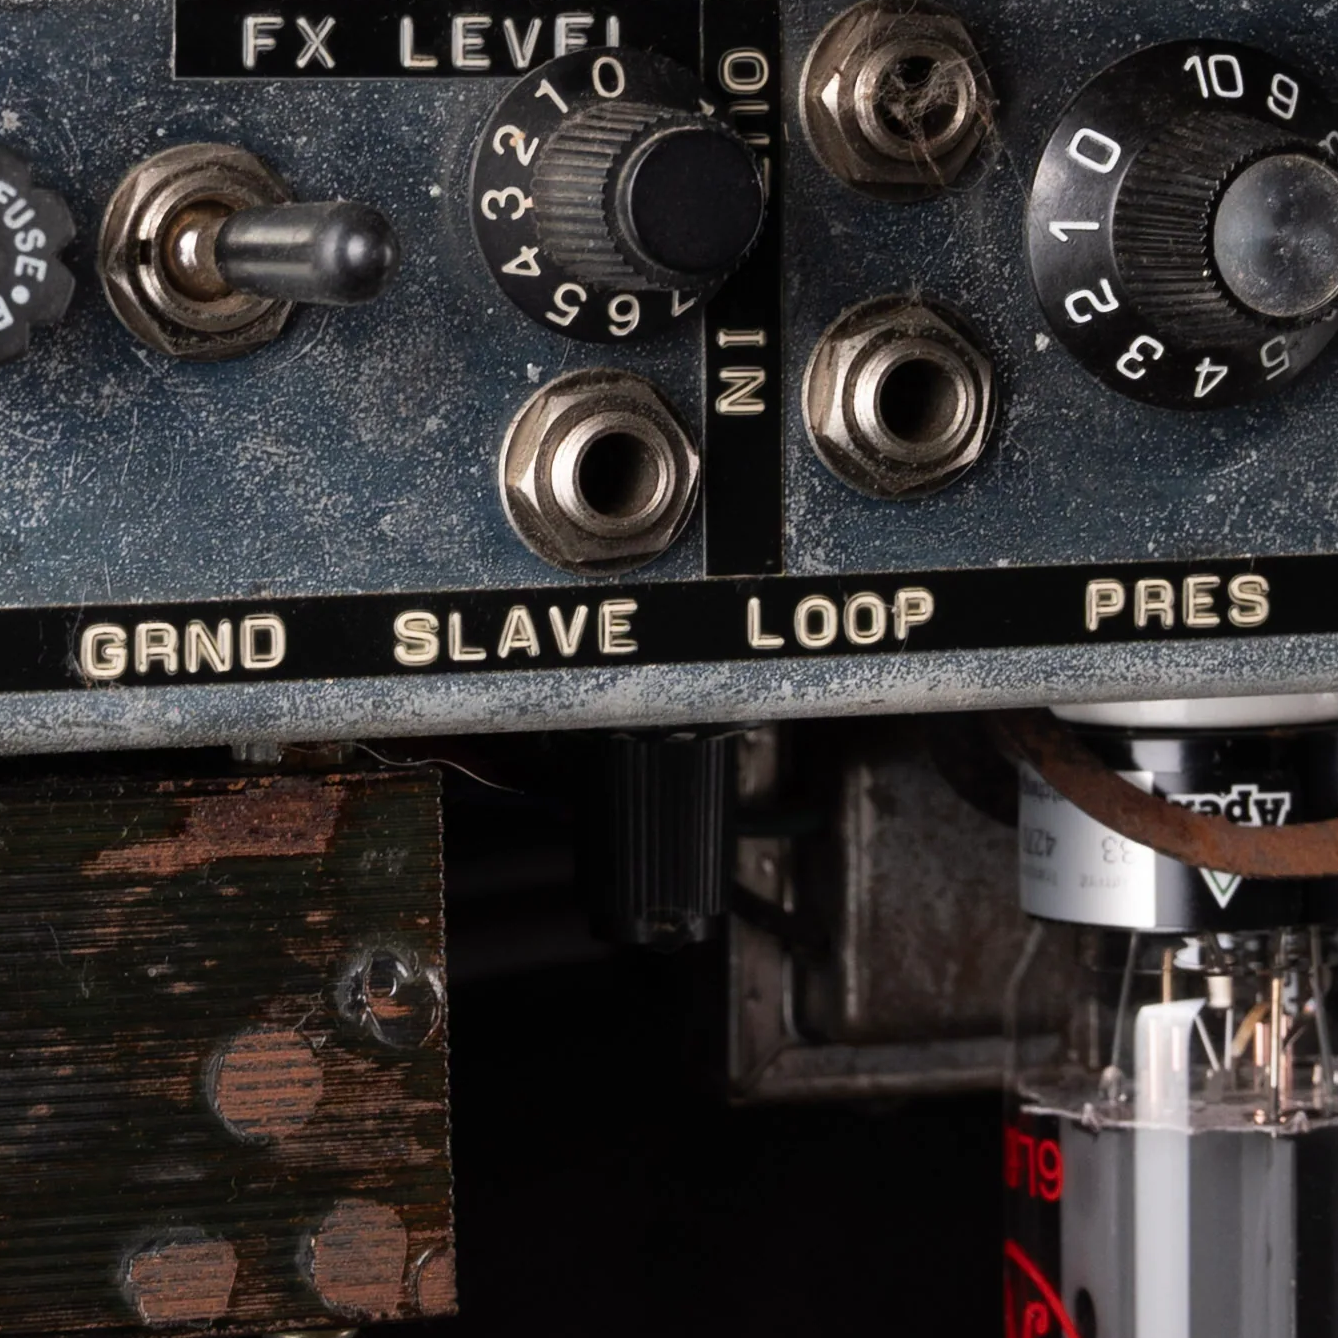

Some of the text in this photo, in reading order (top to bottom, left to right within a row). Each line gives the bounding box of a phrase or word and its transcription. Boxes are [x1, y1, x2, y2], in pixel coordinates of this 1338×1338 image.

[241, 14, 338, 69] FX
[534, 78, 569, 114] 1
[591, 55, 626, 99] 0
[1183, 53, 1300, 121] 10 9
[492, 123, 540, 167] 2
[480, 185, 526, 221] 3
[501, 244, 542, 278] 4
[1047, 127, 1291, 399] 0 1 2 3 4 5
[544, 282, 588, 327] 5
[607, 293, 641, 337] 6
[714, 326, 768, 419] IN
[78, 613, 289, 681] GRND
[392, 599, 641, 663] SLAVE
[745, 588, 937, 650] LOOP
[1084, 573, 1272, 632] PRES
